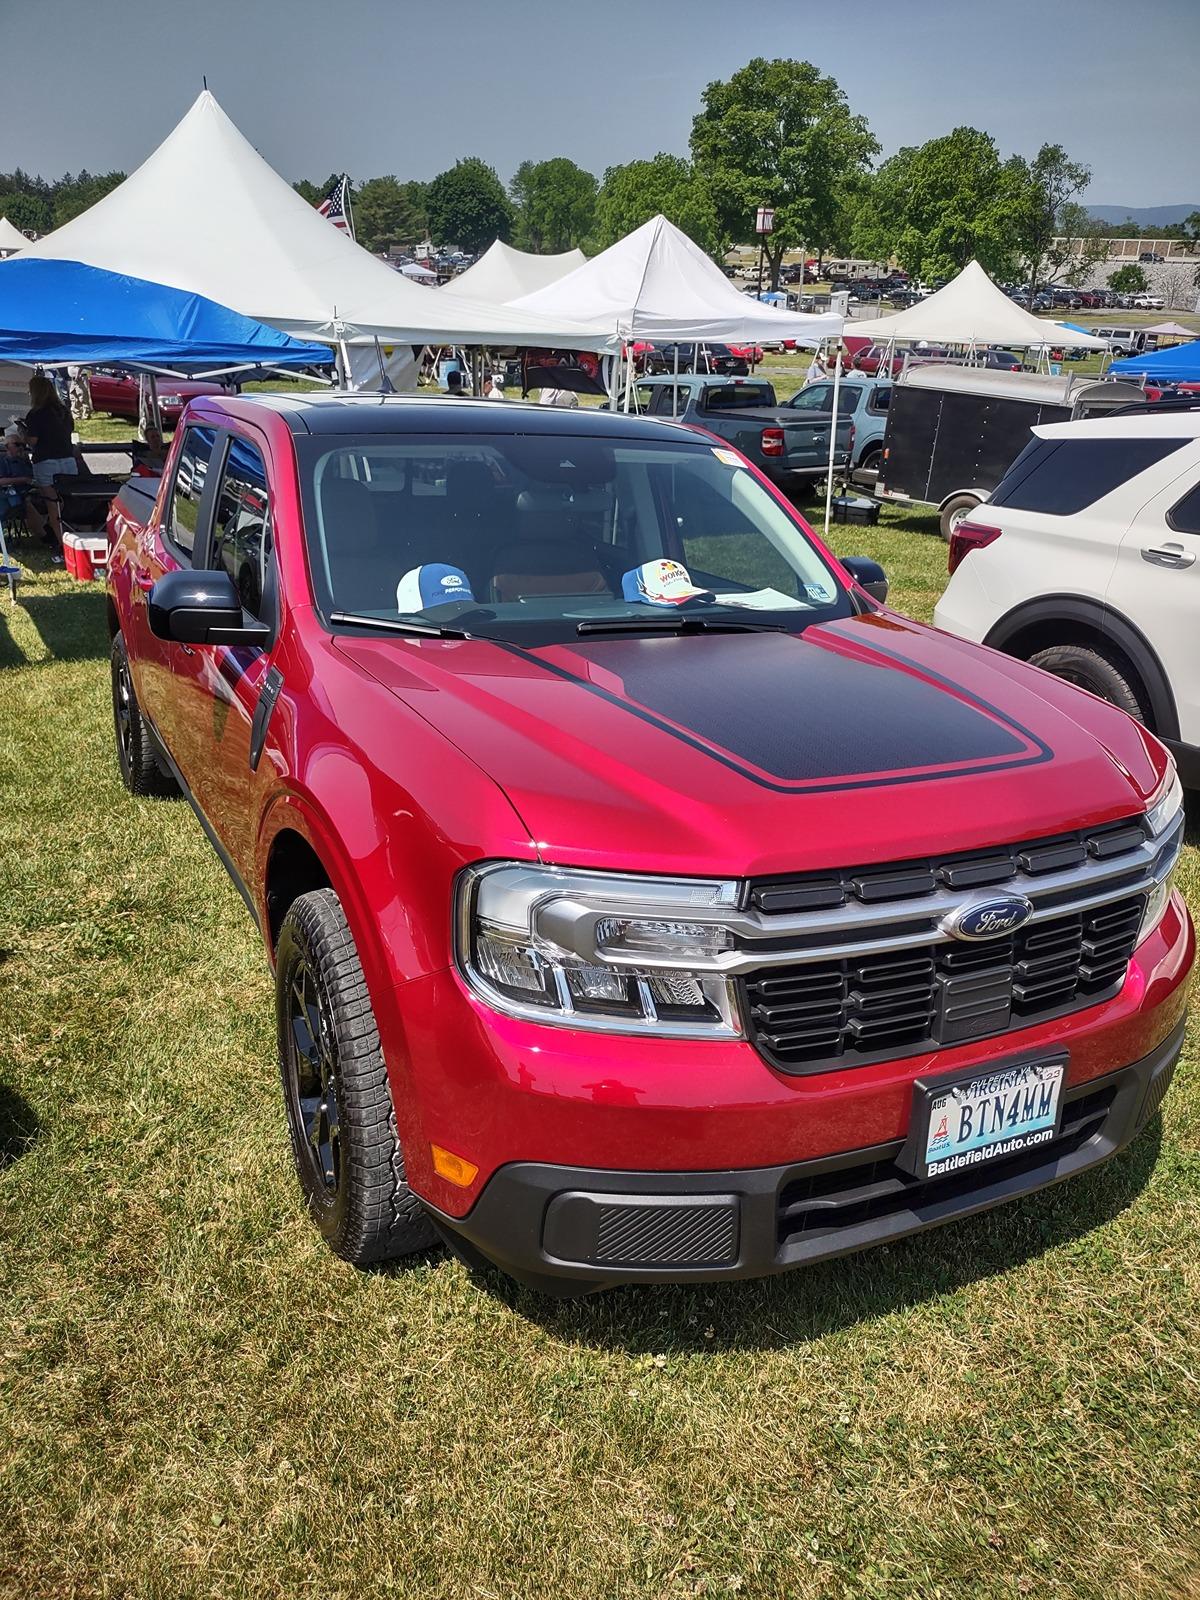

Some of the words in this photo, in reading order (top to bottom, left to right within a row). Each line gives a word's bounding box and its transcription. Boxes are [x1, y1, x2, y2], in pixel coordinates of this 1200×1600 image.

[975, 908, 1017, 933] Ford
[966, 1072, 1029, 1100] VIRGINIA
[970, 1070, 1016, 1088] CULPEPER
[1020, 1066, 1032, 1075] VA
[931, 1098, 947, 1110] AUG
[956, 1080, 1057, 1144] BTN4MM
[927, 1129, 1054, 1178] BattlefieldAuto.com
